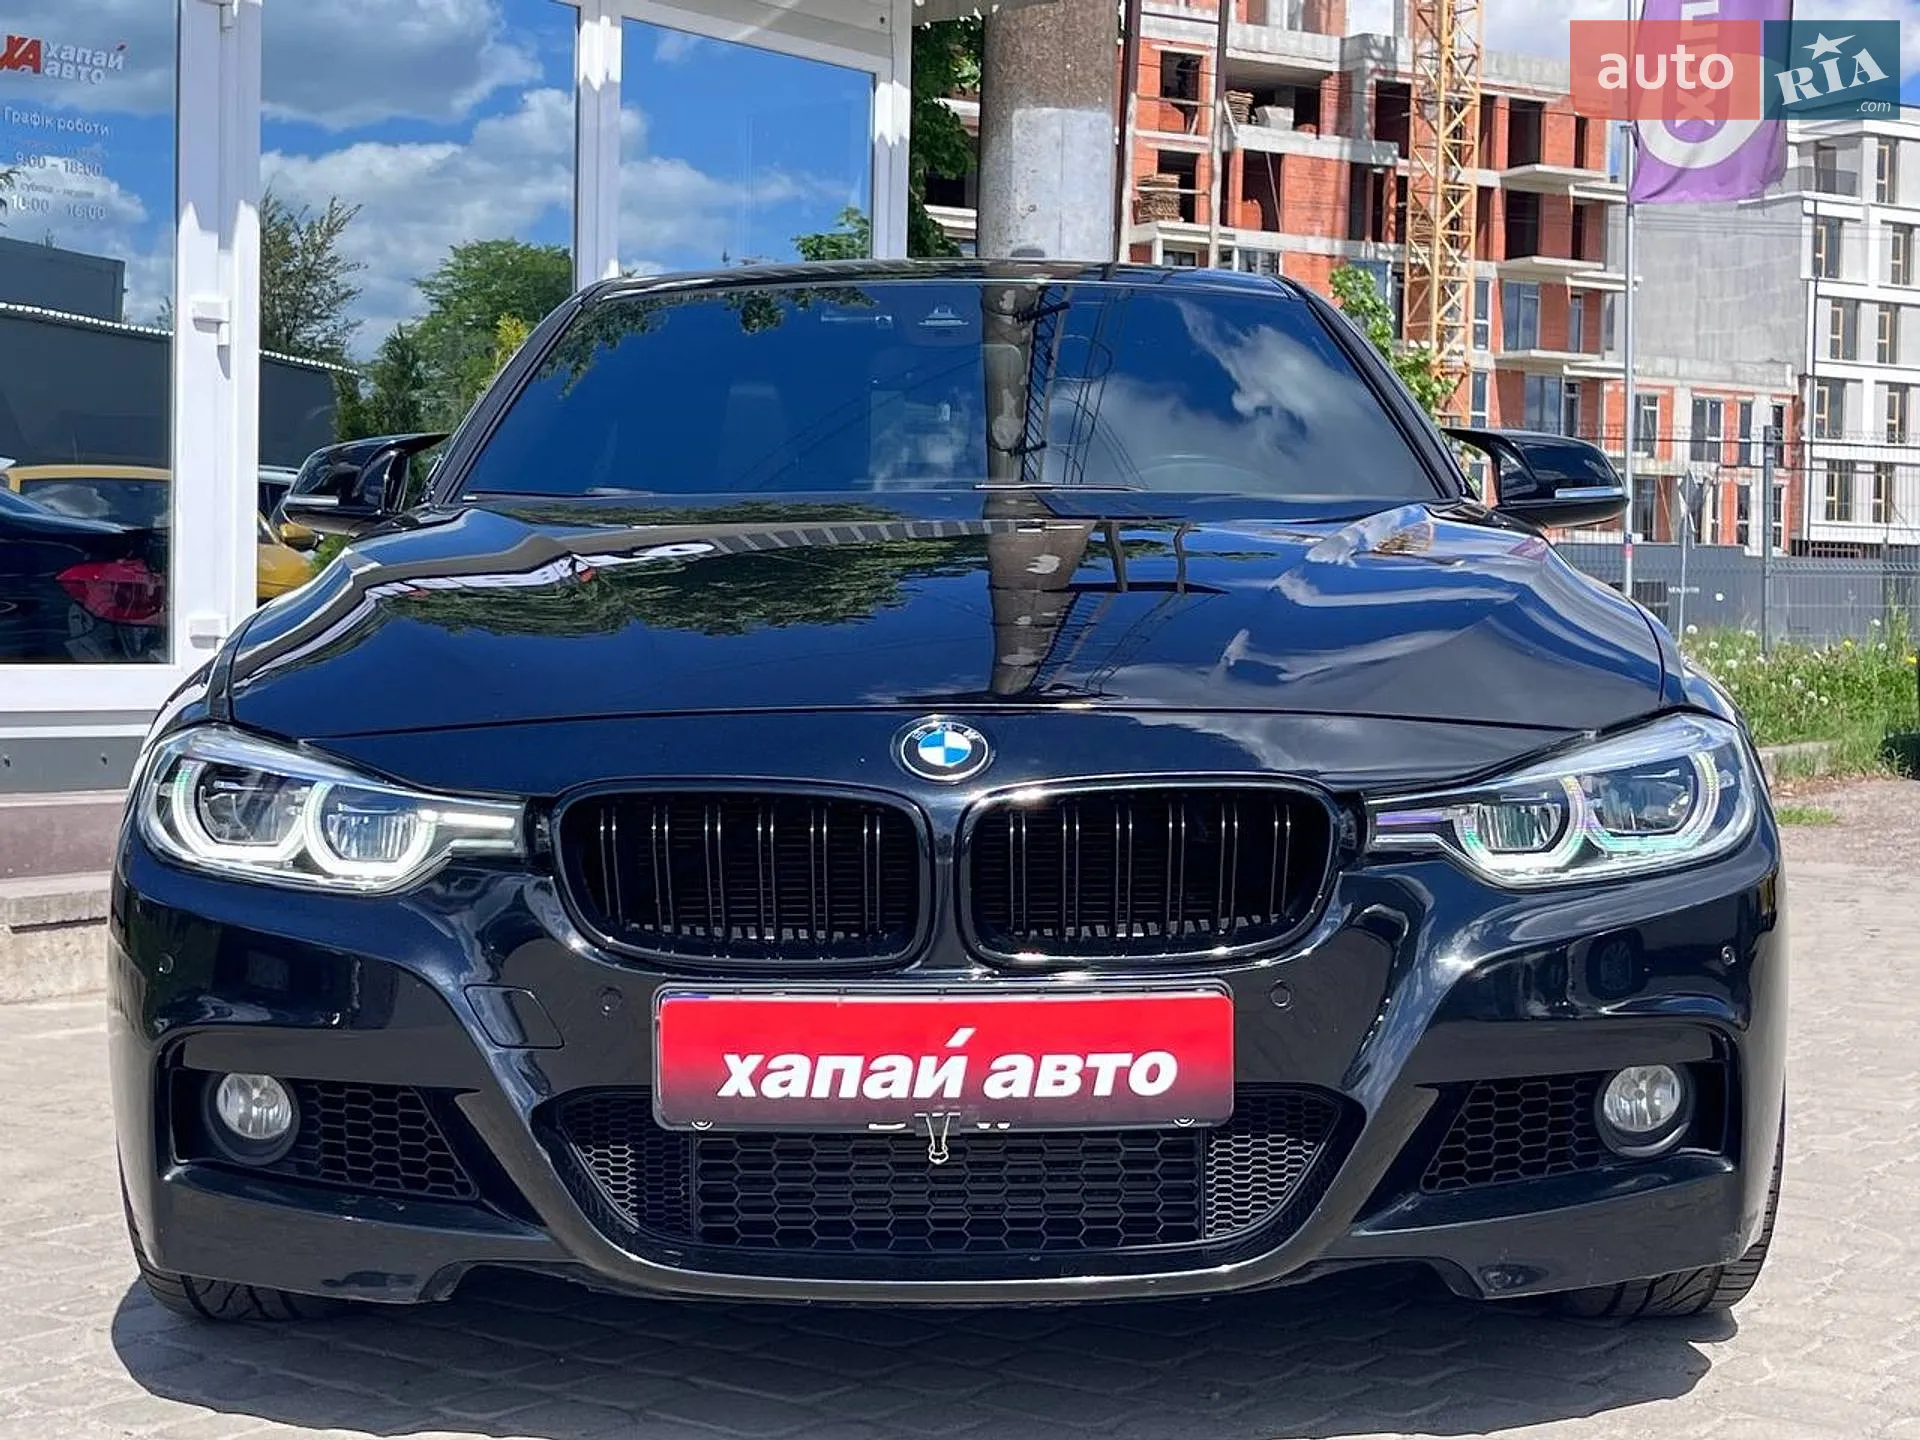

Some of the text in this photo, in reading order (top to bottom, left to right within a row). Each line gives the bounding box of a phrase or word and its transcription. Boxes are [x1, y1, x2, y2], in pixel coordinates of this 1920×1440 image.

[44, 60, 106, 85] авто
[4, 105, 110, 137] Графік роботи
[717, 1026, 1178, 1101] хапай авто
